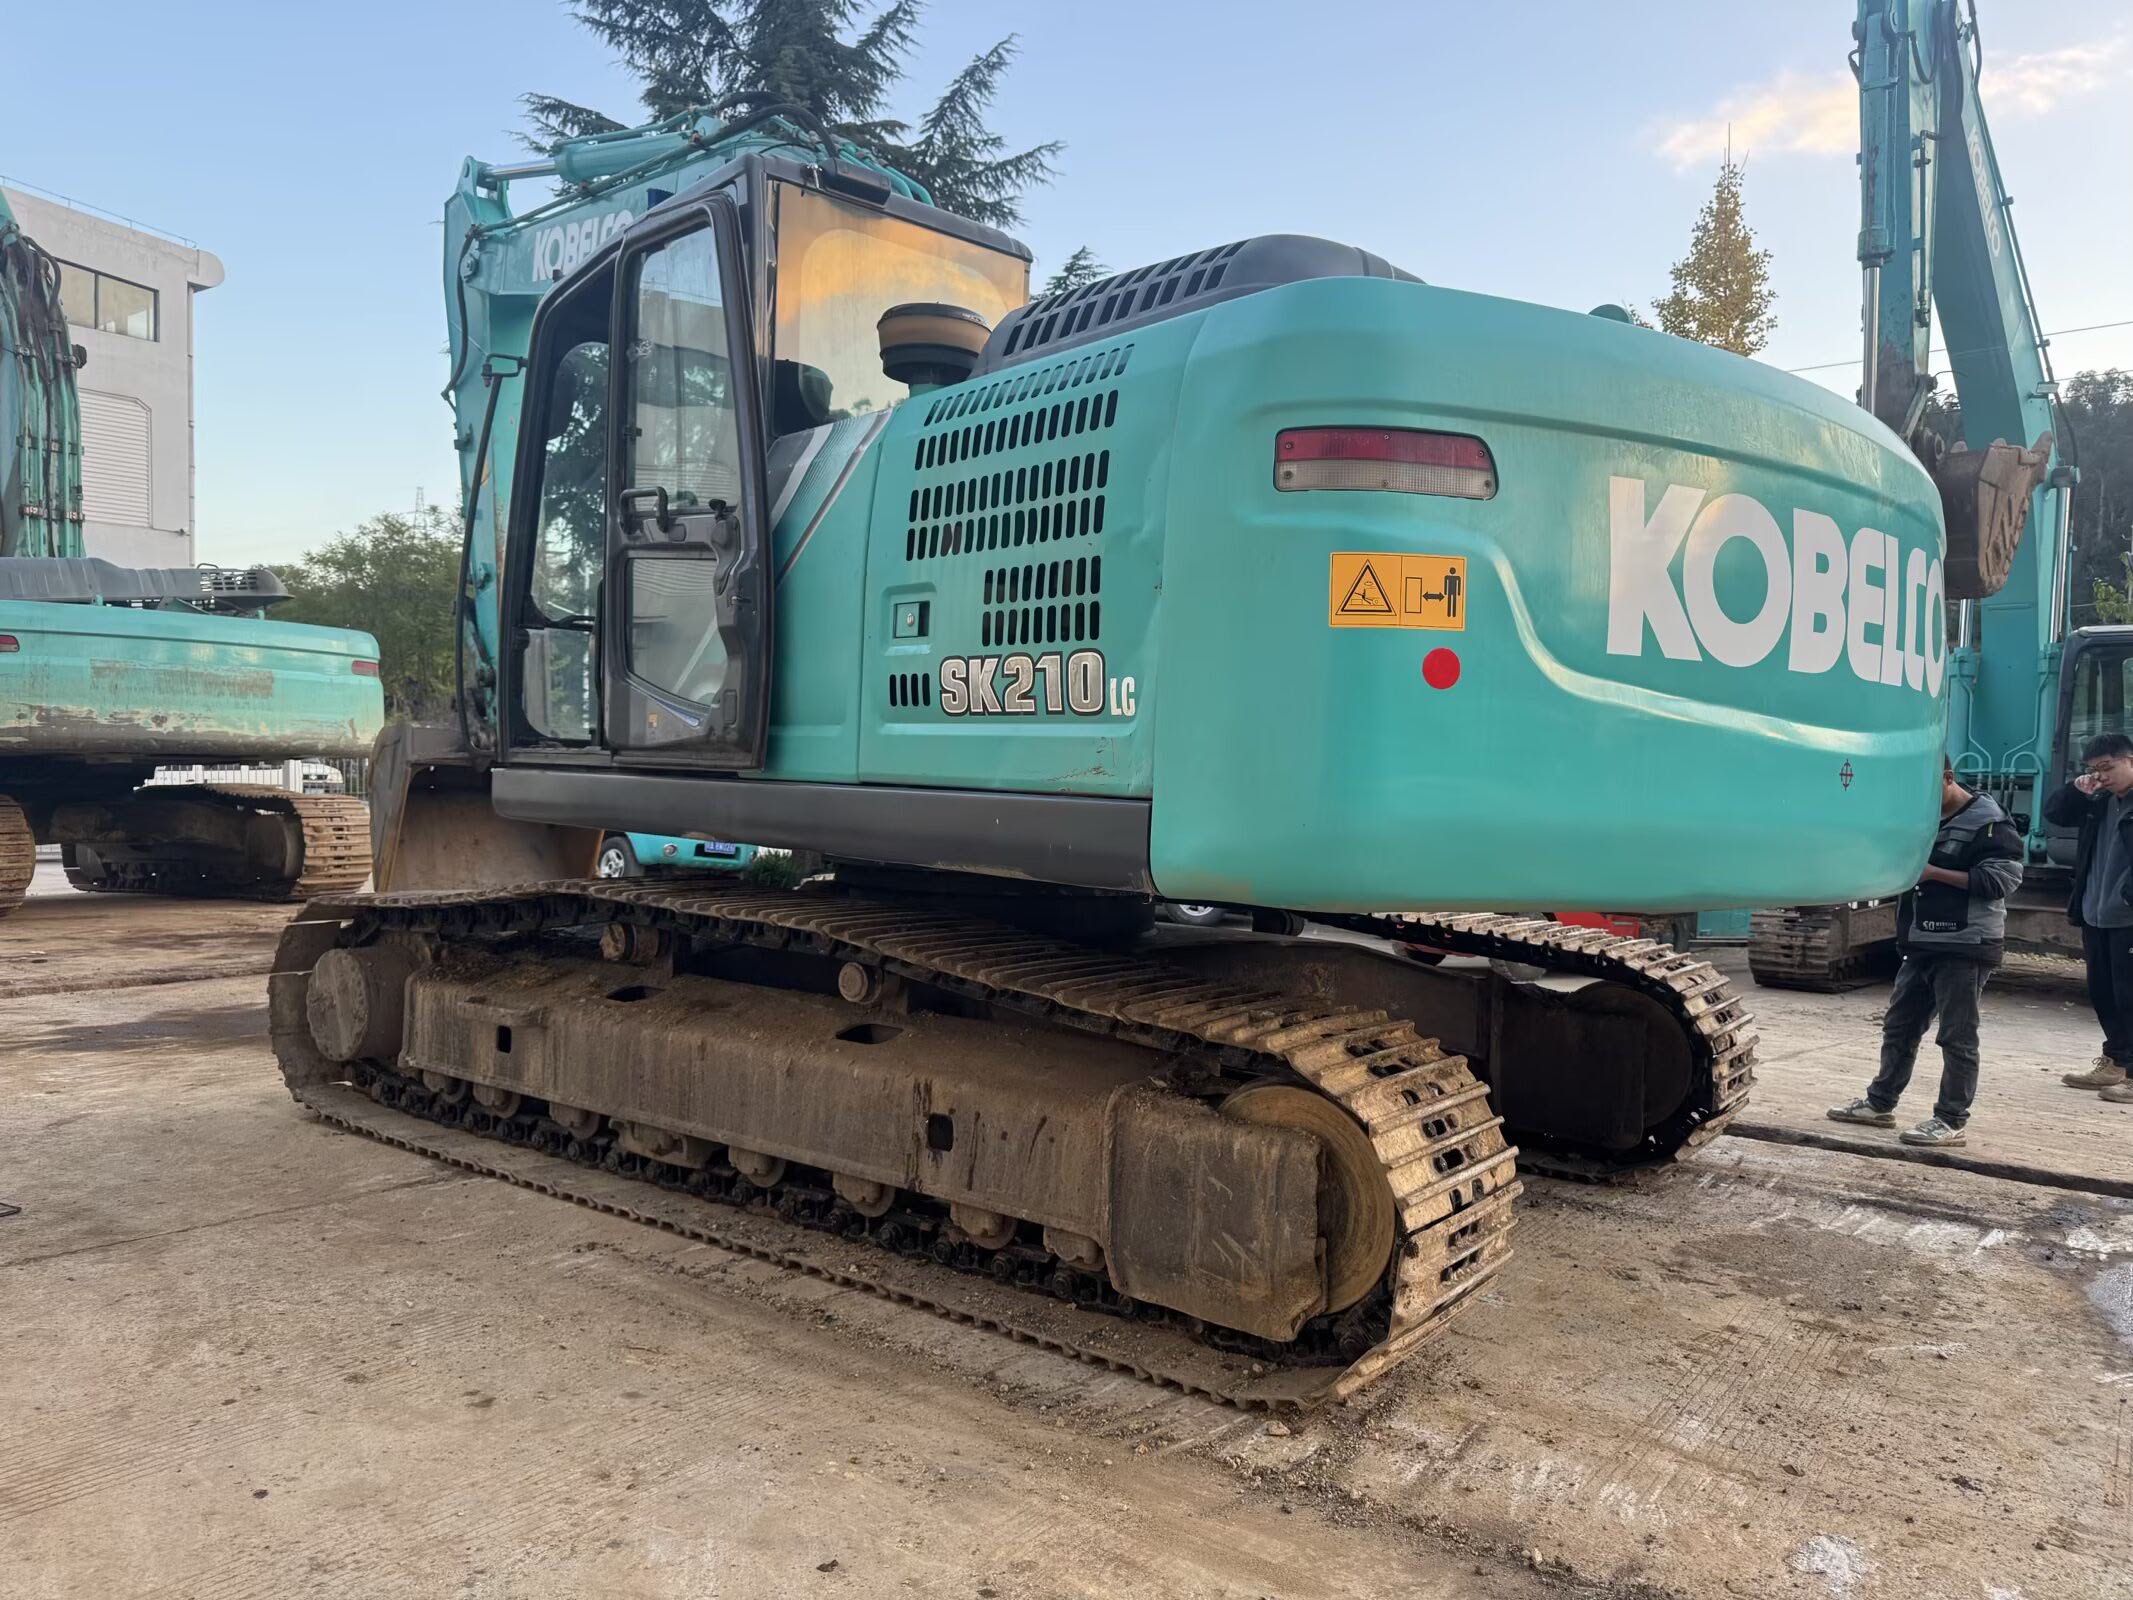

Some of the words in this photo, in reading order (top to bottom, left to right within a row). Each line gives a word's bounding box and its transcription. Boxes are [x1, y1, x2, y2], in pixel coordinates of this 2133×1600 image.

[1606, 475, 1946, 698] KOBELCO
[940, 648, 1105, 716] SK210
[1110, 676, 1136, 716] LC
